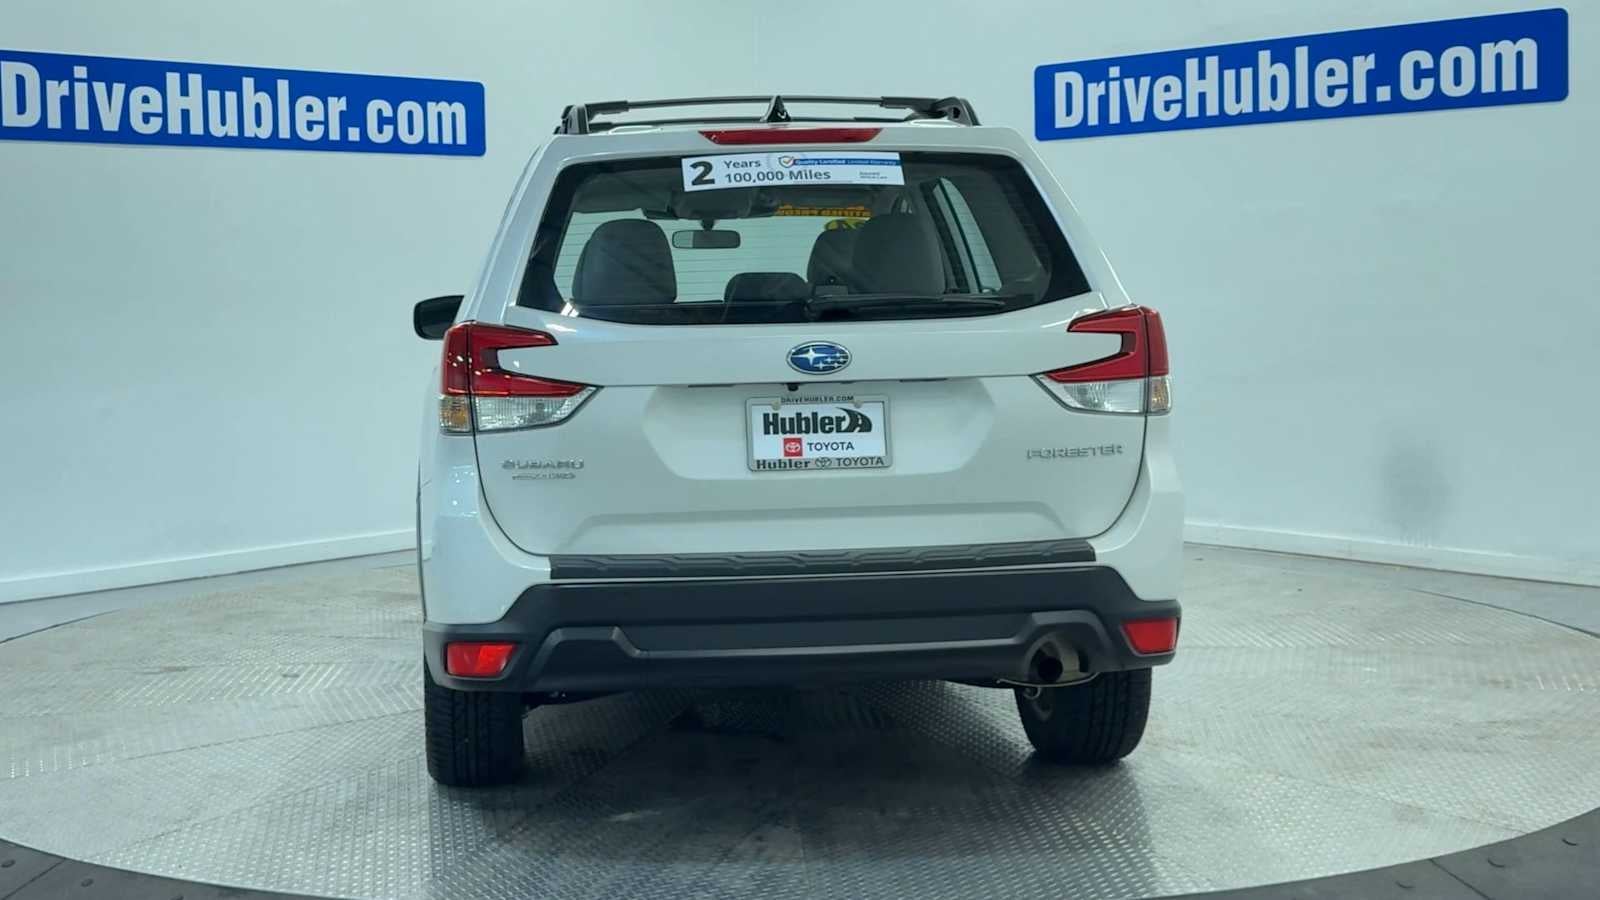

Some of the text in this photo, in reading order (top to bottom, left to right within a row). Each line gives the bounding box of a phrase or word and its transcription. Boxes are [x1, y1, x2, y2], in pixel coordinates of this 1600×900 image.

[1054, 37, 1539, 129] DriveHubler.com
[0, 60, 468, 146] DriveHubler.com
[724, 159, 761, 170] Years
[690, 160, 715, 186] 2
[725, 169, 831, 184] 100,000 Miles
[762, 410, 846, 435] Hubler
[807, 441, 855, 452] TOYOTA
[1026, 443, 1124, 460] FORESTER
[502, 458, 584, 470] SUBARU
[756, 456, 884, 470] Hubler TOYOTA
